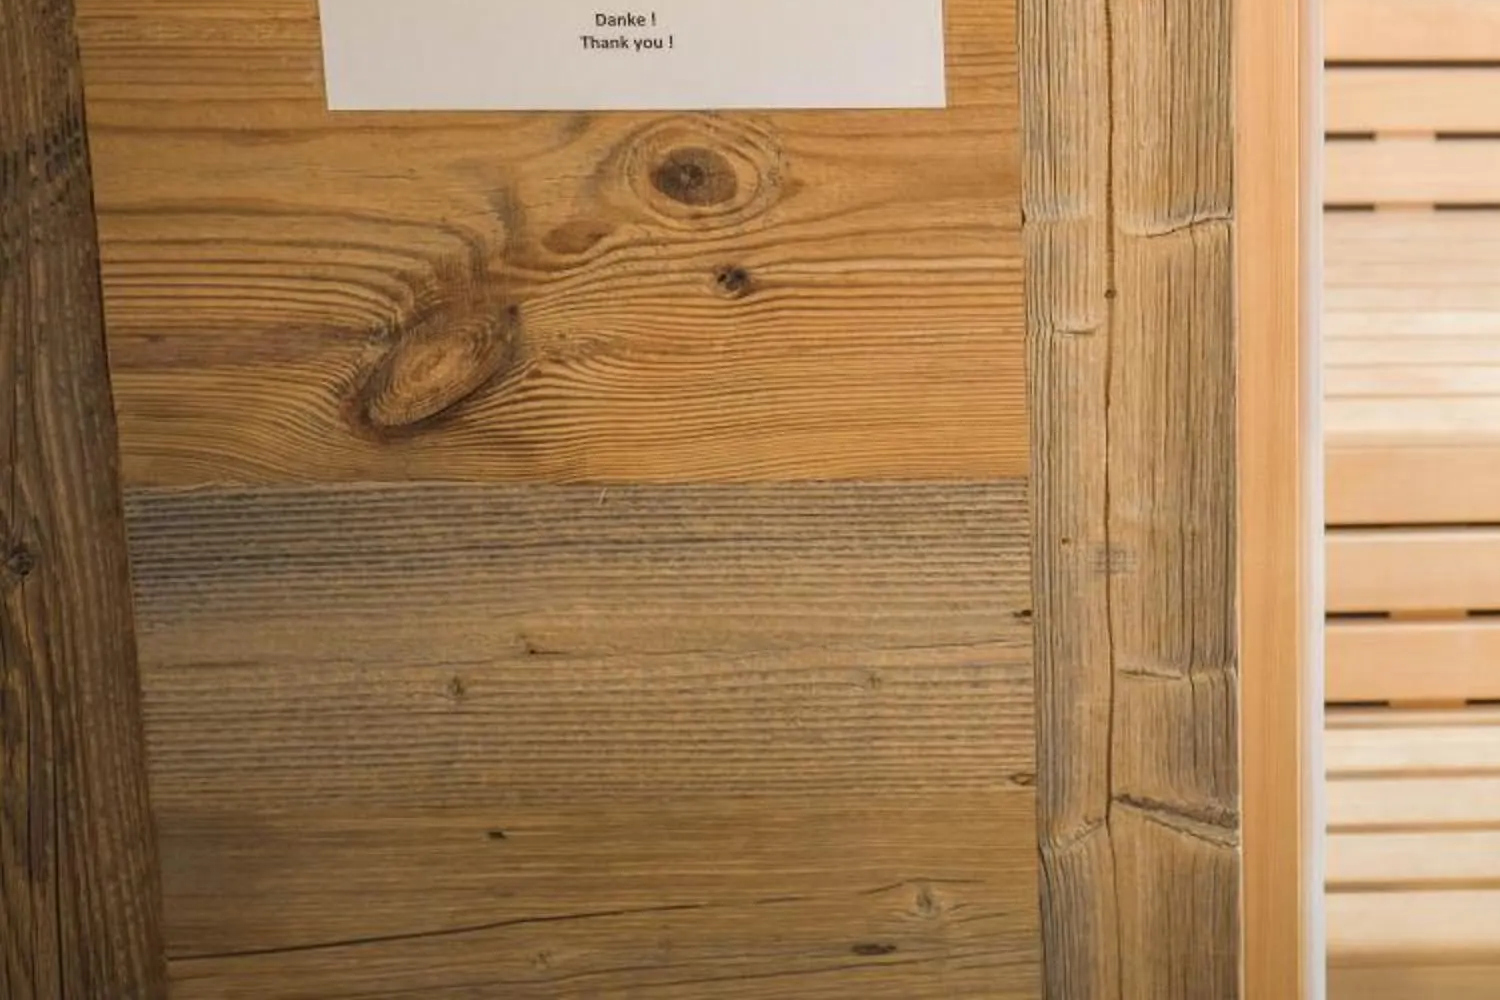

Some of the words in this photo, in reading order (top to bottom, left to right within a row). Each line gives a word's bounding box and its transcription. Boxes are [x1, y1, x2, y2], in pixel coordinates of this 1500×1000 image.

[594, 11, 647, 28] Danke
[579, 34, 630, 50] Thank
[633, 37, 664, 53] you
